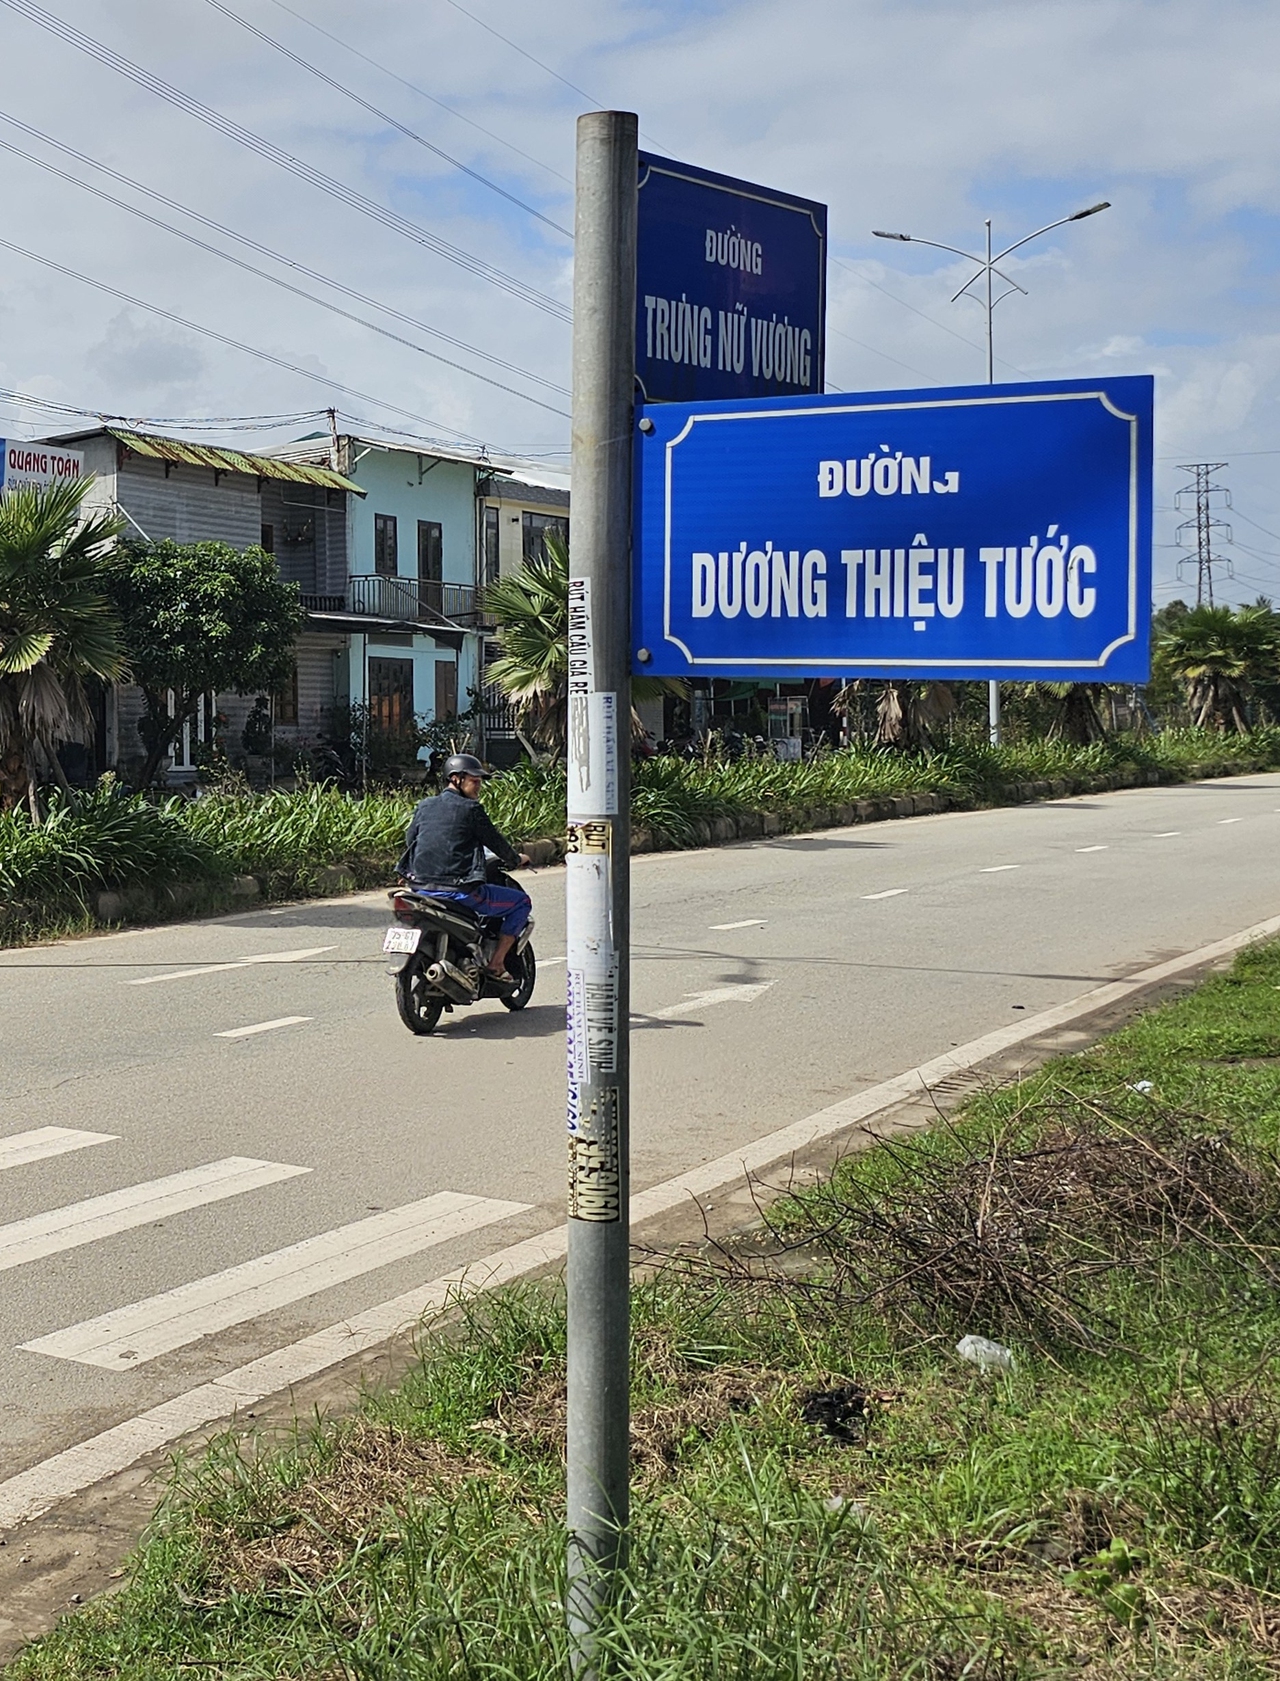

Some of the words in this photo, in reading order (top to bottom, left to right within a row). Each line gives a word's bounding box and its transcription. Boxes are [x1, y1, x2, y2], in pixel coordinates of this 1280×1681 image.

[705, 224, 762, 275] ĐƯỜNG
[645, 293, 712, 368] TRƯNG
[718, 302, 747, 374] NỮ
[751, 313, 812, 387] VƯƠNG
[9, 449, 47, 474] QUANG
[50, 453, 79, 479] TOÀN
[569, 580, 590, 601] RÚT
[691, 541, 827, 618] DƯƠNG
[841, 533, 965, 631] THIỆU
[979, 524, 1097, 618] TƯỚC
[569, 606, 590, 630] HẦM
[569, 634, 591, 655] CẦU
[570, 659, 593, 677] GIÁ
[585, 825, 610, 850] RÚT
[586, 983, 618, 1012] HẦM
[577, 1051, 585, 1079] SINH
[588, 1039, 614, 1070] SINH
